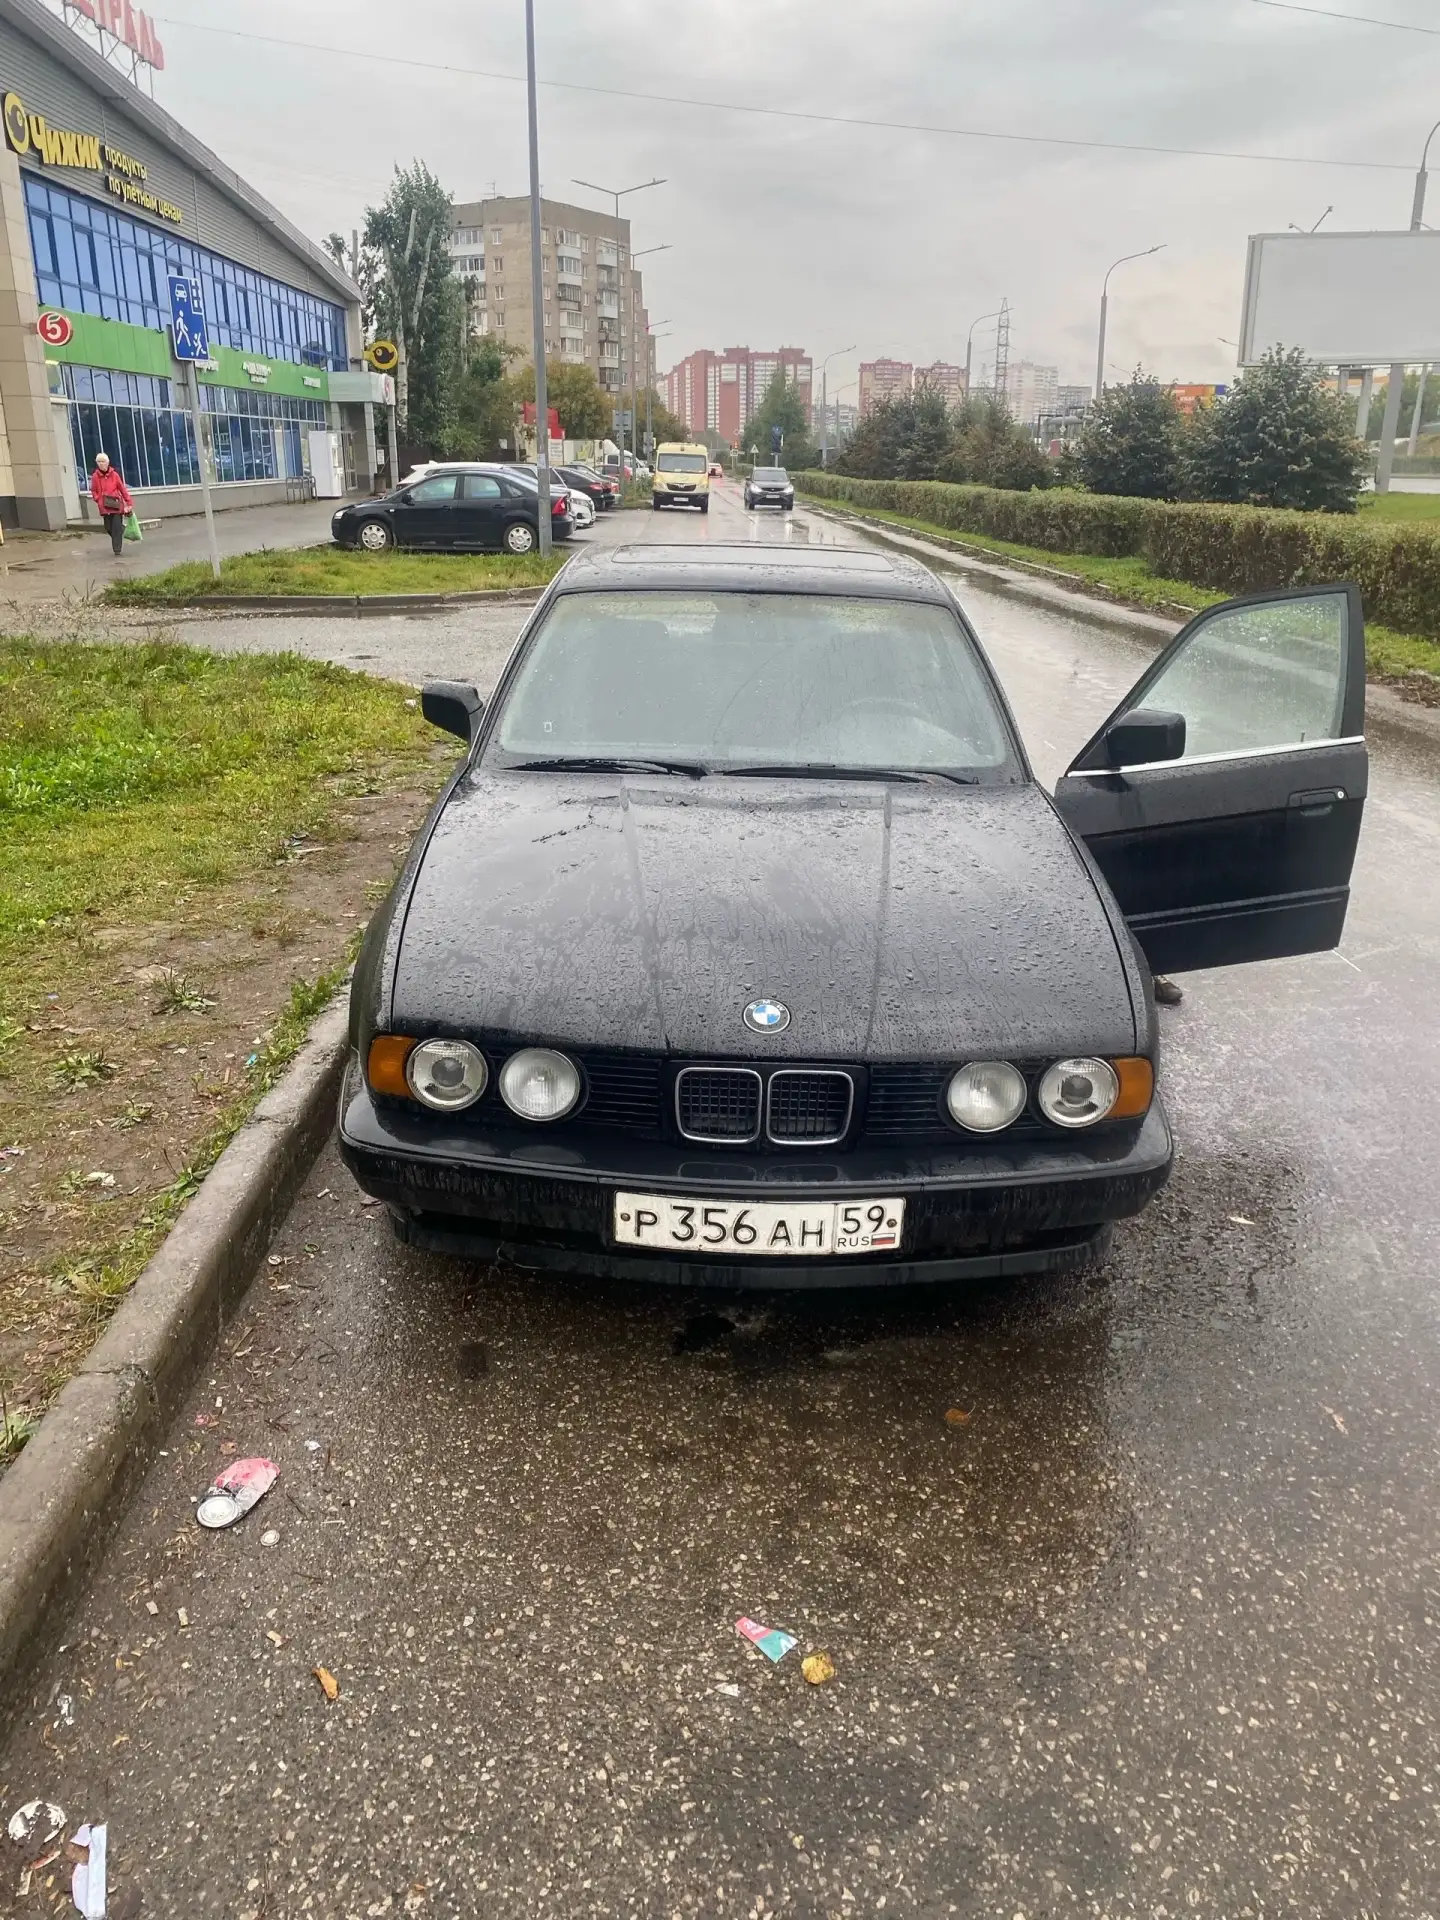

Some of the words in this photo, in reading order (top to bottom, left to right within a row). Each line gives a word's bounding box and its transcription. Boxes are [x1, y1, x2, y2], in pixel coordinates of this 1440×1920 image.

[104, 145, 148, 180] продукты
[108, 175, 121, 195] по
[158, 199, 182, 222] ценам
[841, 1204, 886, 1234] 59
[836, 1236, 871, 1248] RUS
